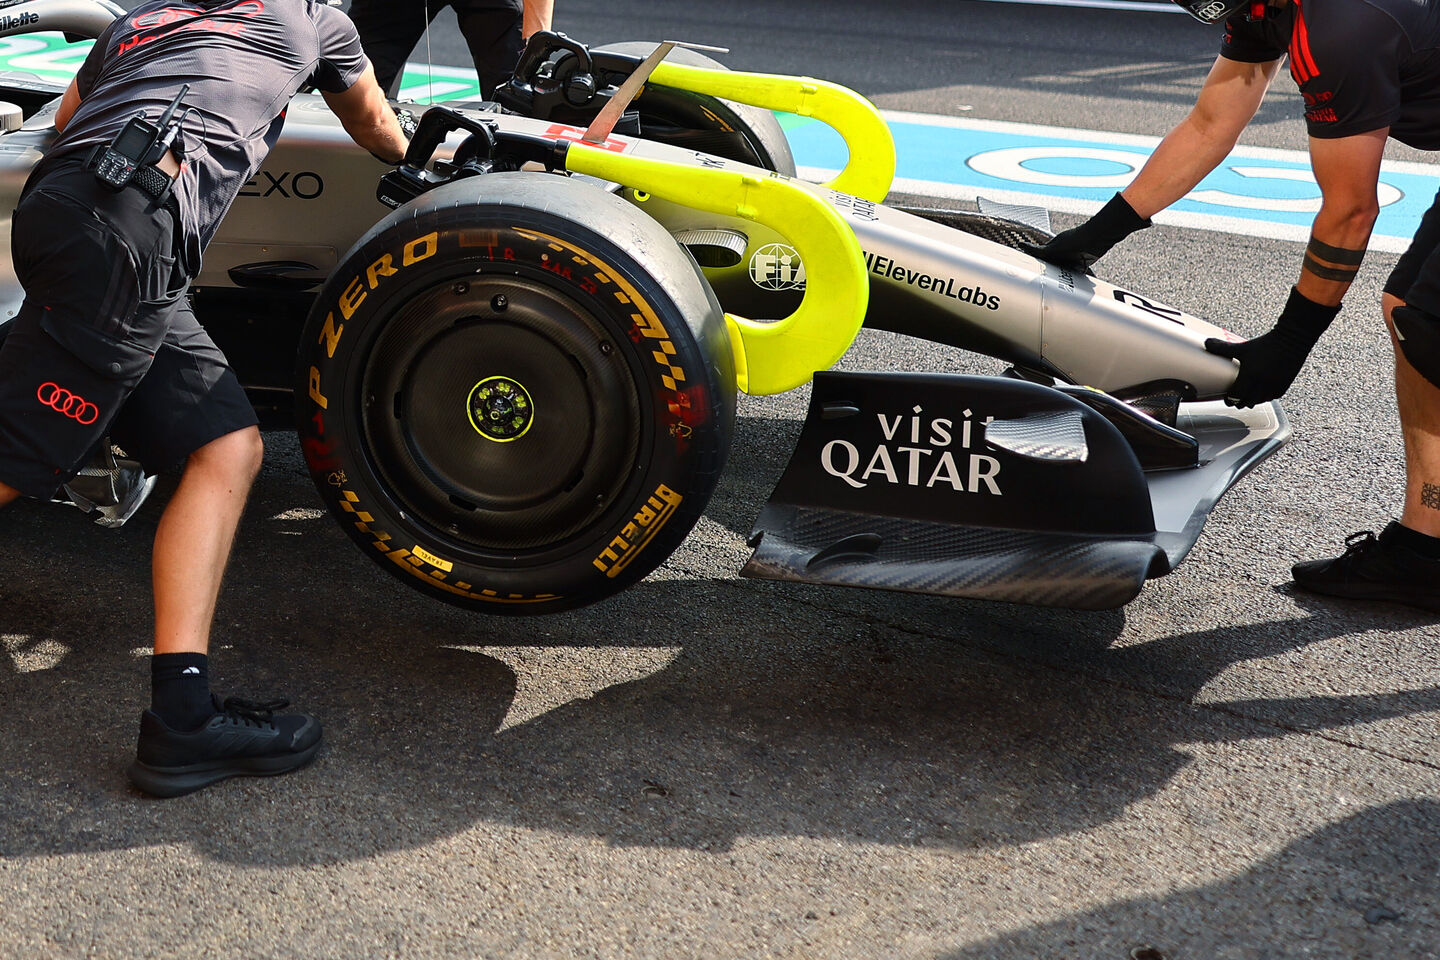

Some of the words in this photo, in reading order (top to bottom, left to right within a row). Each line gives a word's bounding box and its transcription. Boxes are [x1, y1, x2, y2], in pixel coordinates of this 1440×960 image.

[308, 365, 329, 410] P
[319, 231, 439, 358] ZERO
[821, 439, 1002, 497] QATAR
[593, 483, 684, 578] PIRELLI
